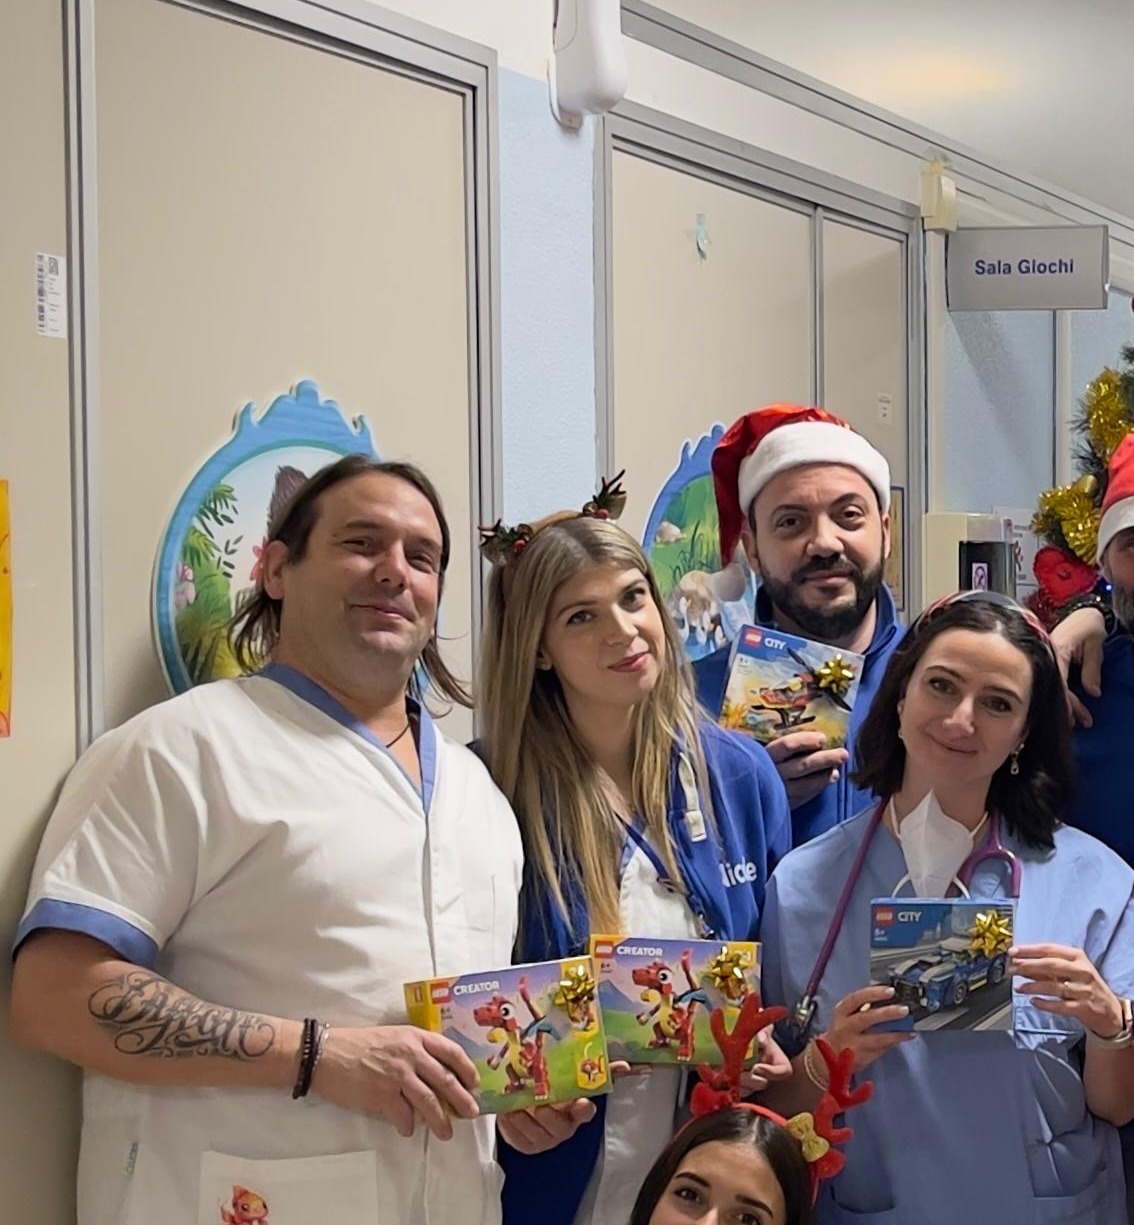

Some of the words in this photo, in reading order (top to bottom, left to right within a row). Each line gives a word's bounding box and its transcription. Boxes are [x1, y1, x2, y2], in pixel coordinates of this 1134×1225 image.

[974, 259, 1012, 275] Sala
[1018, 258, 1074, 275] Giochi
[764, 637, 786, 650] CITY
[897, 911, 922, 922] CITY
[616, 946, 663, 957] CREATOR
[453, 980, 500, 997] CREATOR
